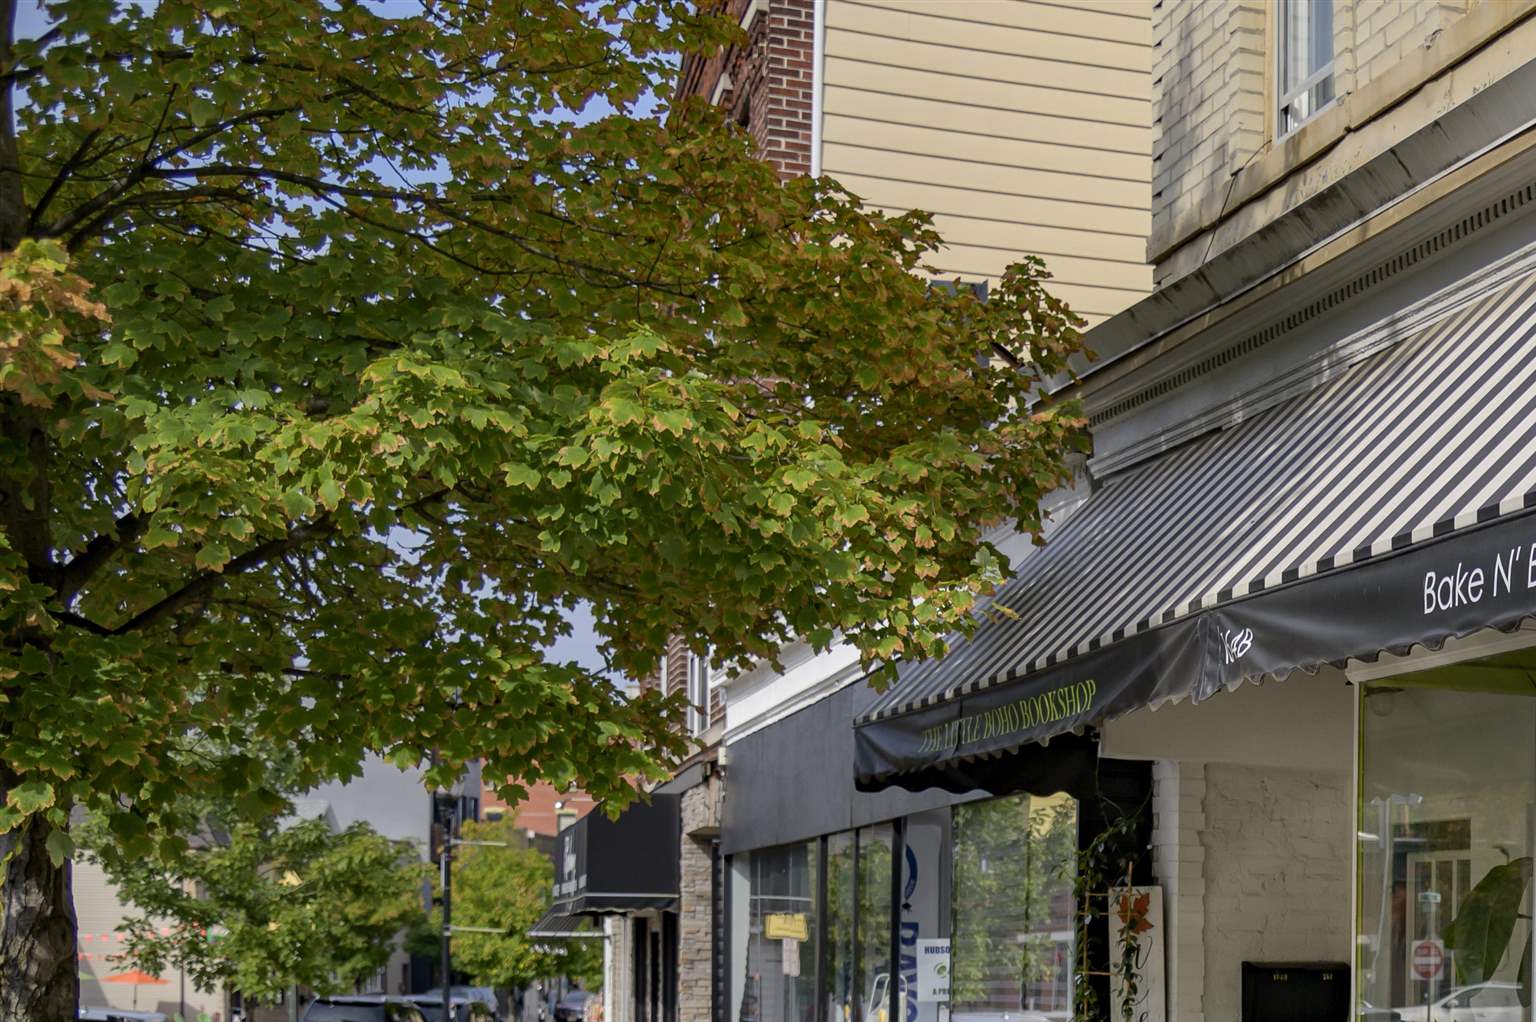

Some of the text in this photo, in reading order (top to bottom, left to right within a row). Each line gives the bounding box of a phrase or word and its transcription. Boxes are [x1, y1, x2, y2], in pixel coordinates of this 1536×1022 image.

[1423, 562, 1485, 614] Bake
[1493, 545, 1522, 597] N'
[983, 703, 1019, 739] BOHO
[1020, 679, 1097, 730] BOOKSHOP
